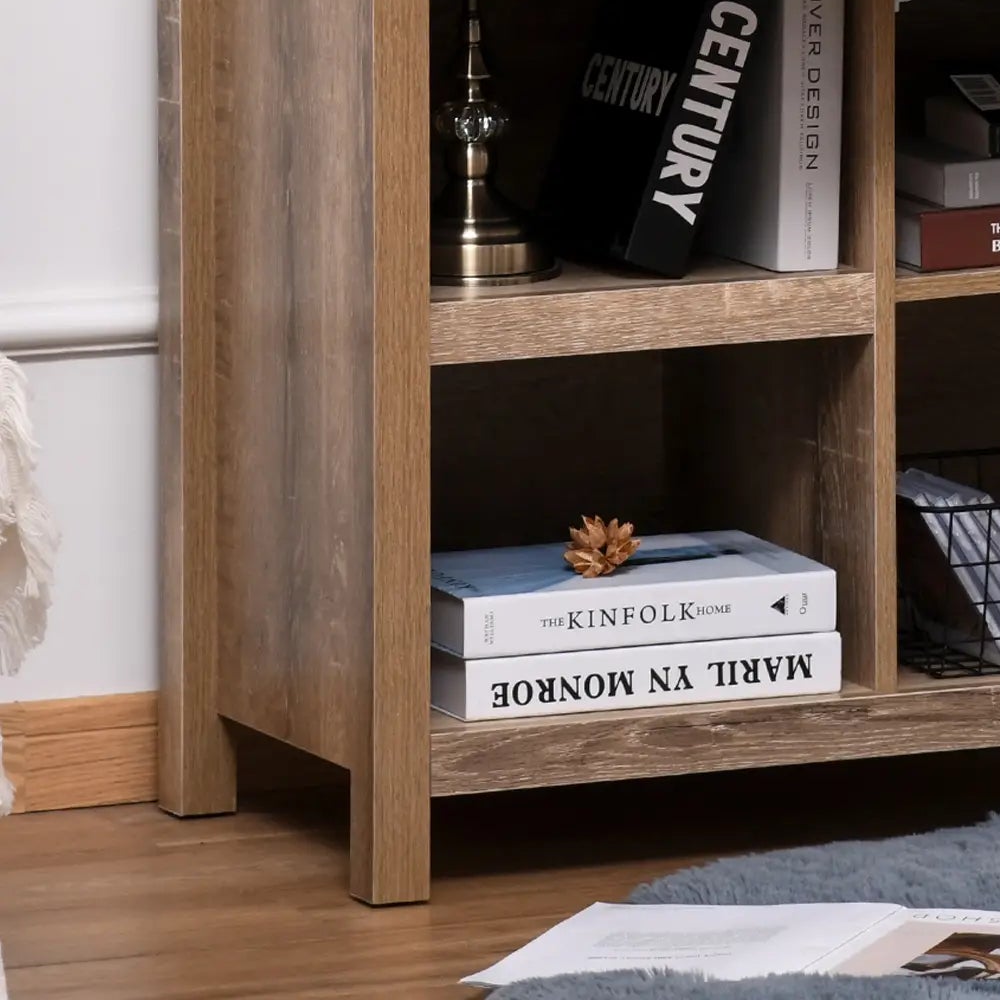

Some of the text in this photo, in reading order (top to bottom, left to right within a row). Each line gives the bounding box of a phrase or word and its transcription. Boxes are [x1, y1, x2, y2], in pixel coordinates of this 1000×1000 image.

[581, 52, 679, 118] CENTURY
[652, 1, 758, 226] CENTURY
[805, 67, 821, 170] DESIGN
[540, 601, 732, 630] THE KINFOLK HOME
[491, 653, 813, 709] MARIL YN MONROE
